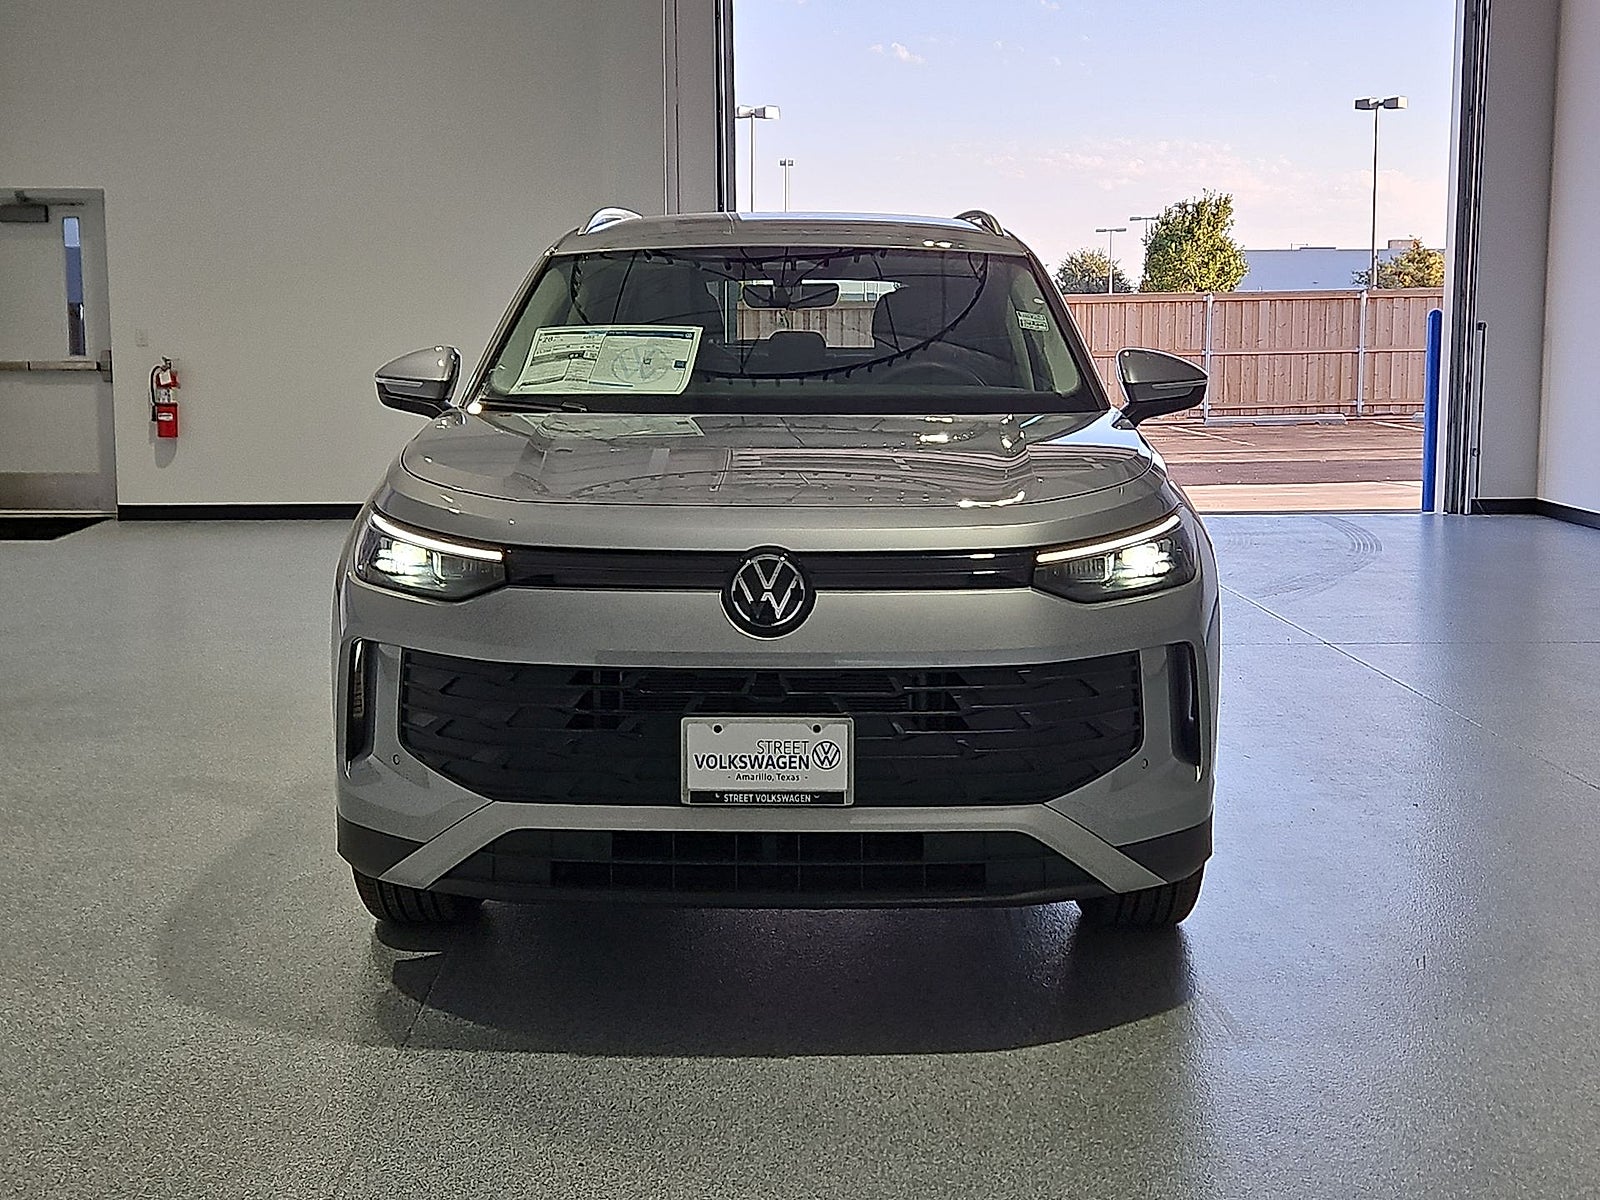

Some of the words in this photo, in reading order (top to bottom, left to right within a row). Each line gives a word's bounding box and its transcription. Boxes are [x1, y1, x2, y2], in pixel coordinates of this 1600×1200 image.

[757, 740, 809, 754] STREET
[694, 754, 809, 770] VOLKSWAGEN
[735, 773, 774, 782] Amarillo,
[777, 773, 800, 781] Texas
[724, 794, 753, 803] STREET
[756, 794, 811, 803] VOLKSWAGEN
